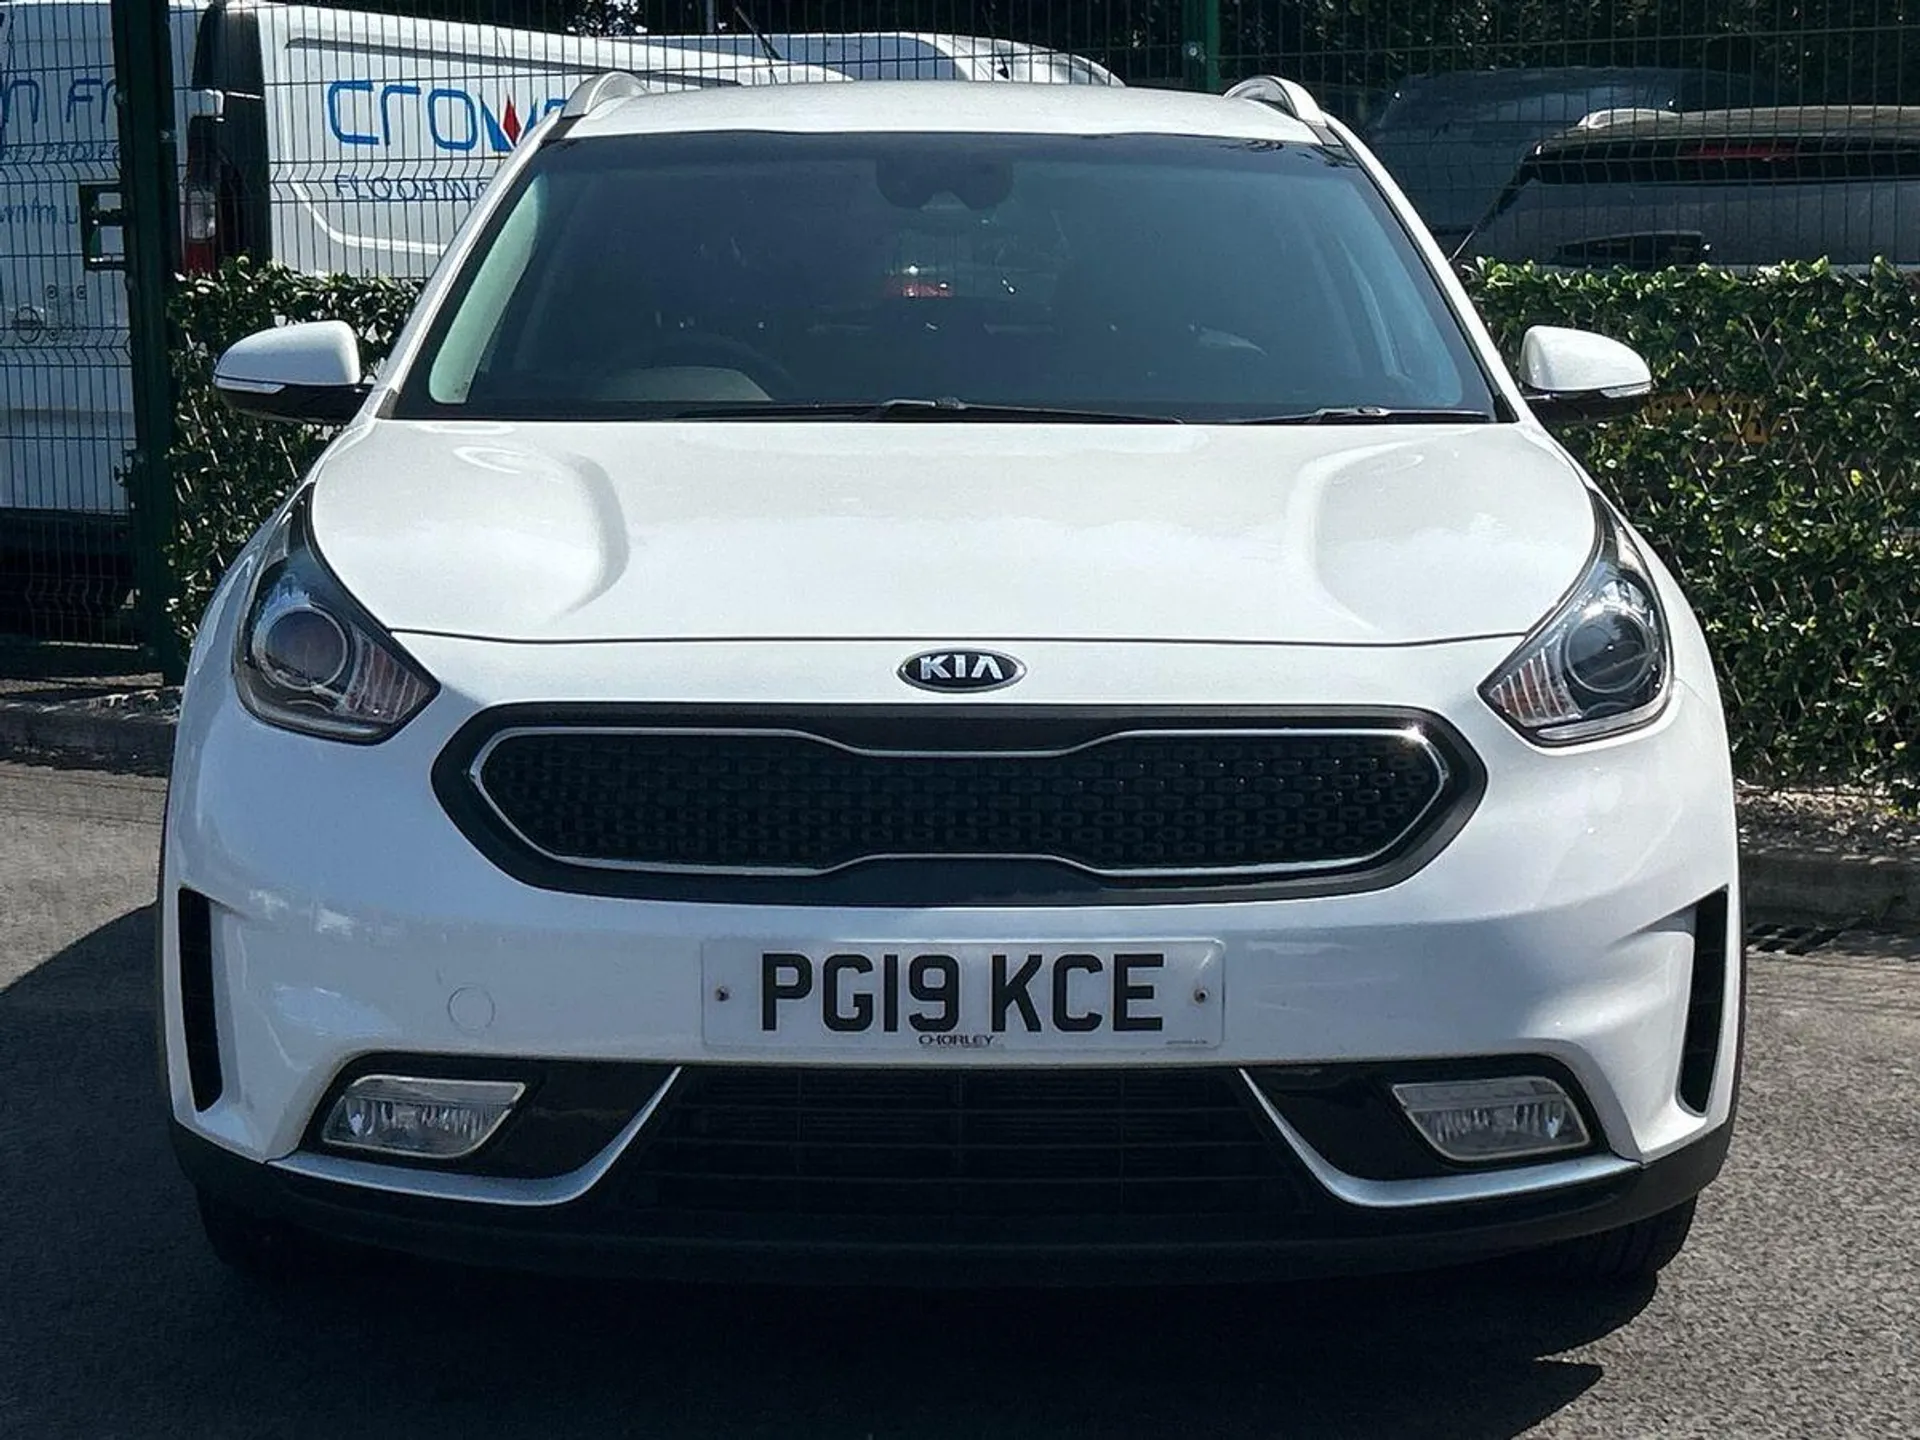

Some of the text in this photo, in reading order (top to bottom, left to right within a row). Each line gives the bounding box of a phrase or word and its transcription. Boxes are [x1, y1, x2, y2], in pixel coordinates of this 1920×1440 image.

[920, 654, 1004, 680] KIA
[761, 953, 1164, 1032] PG19 KCE
[918, 1034, 994, 1047] CHORLEY
